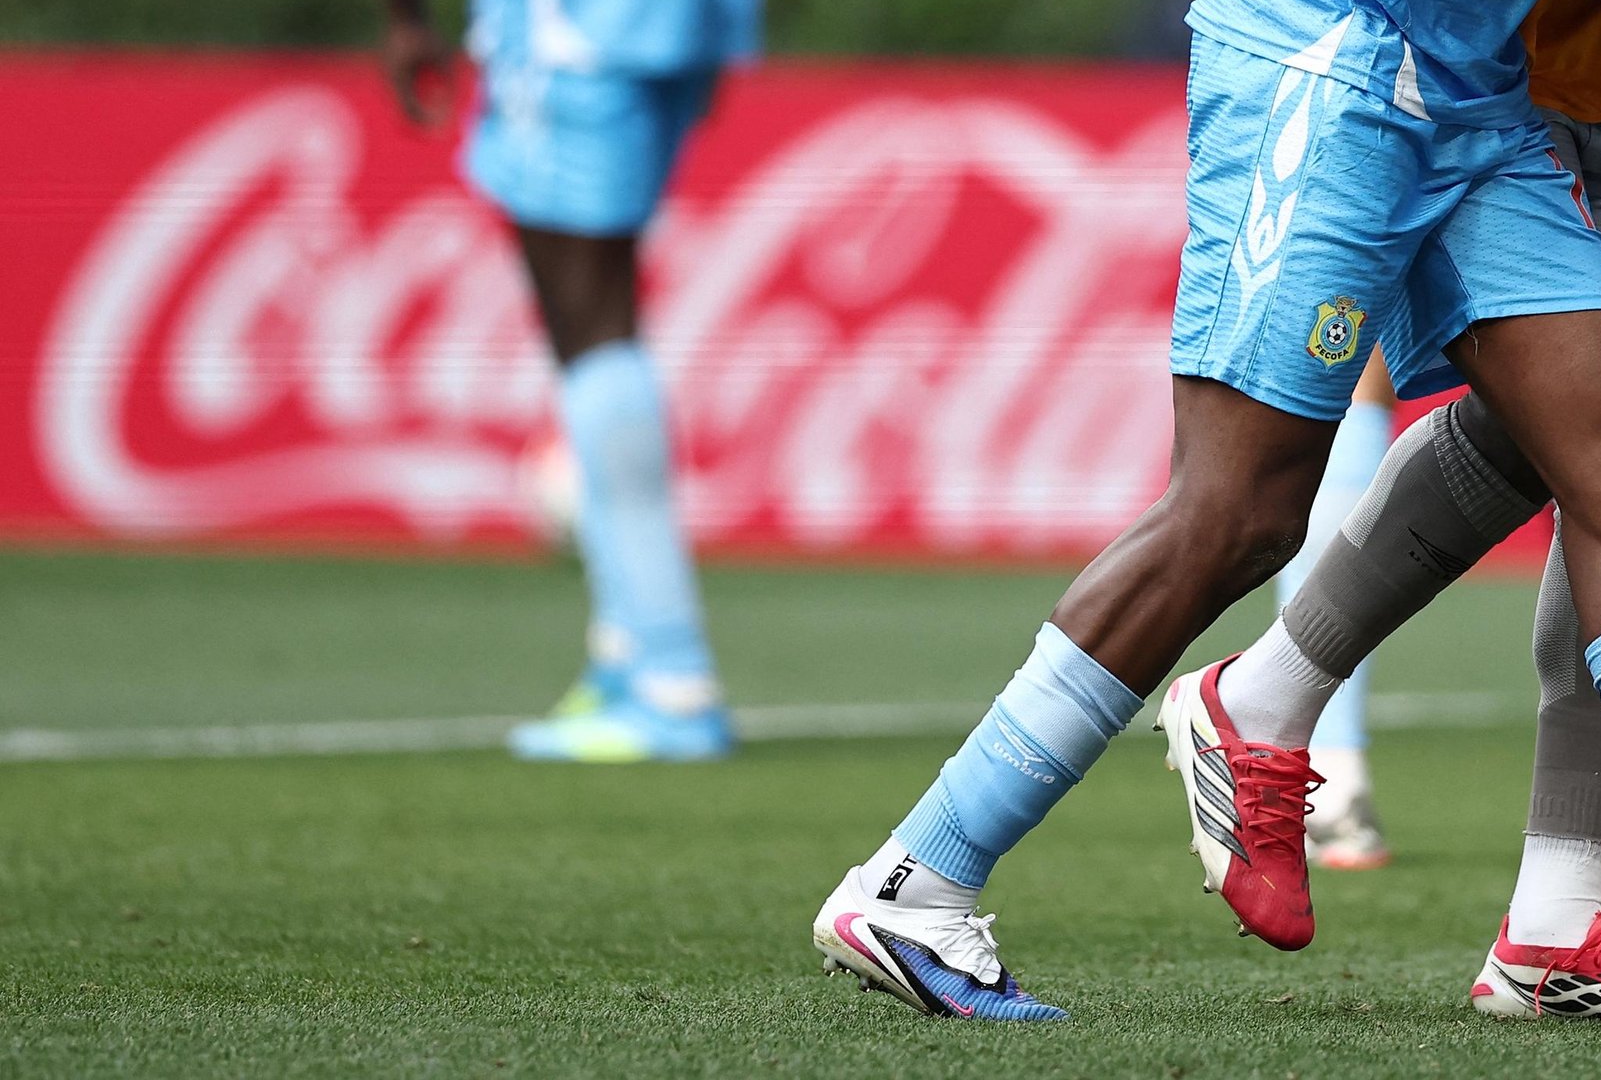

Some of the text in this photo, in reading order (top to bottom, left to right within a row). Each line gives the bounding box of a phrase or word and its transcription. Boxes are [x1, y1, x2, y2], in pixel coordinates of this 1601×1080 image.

[33, 85, 1186, 542] CocaCola
[1315, 343, 1349, 360] FECOFA
[993, 741, 1056, 784] umbro
